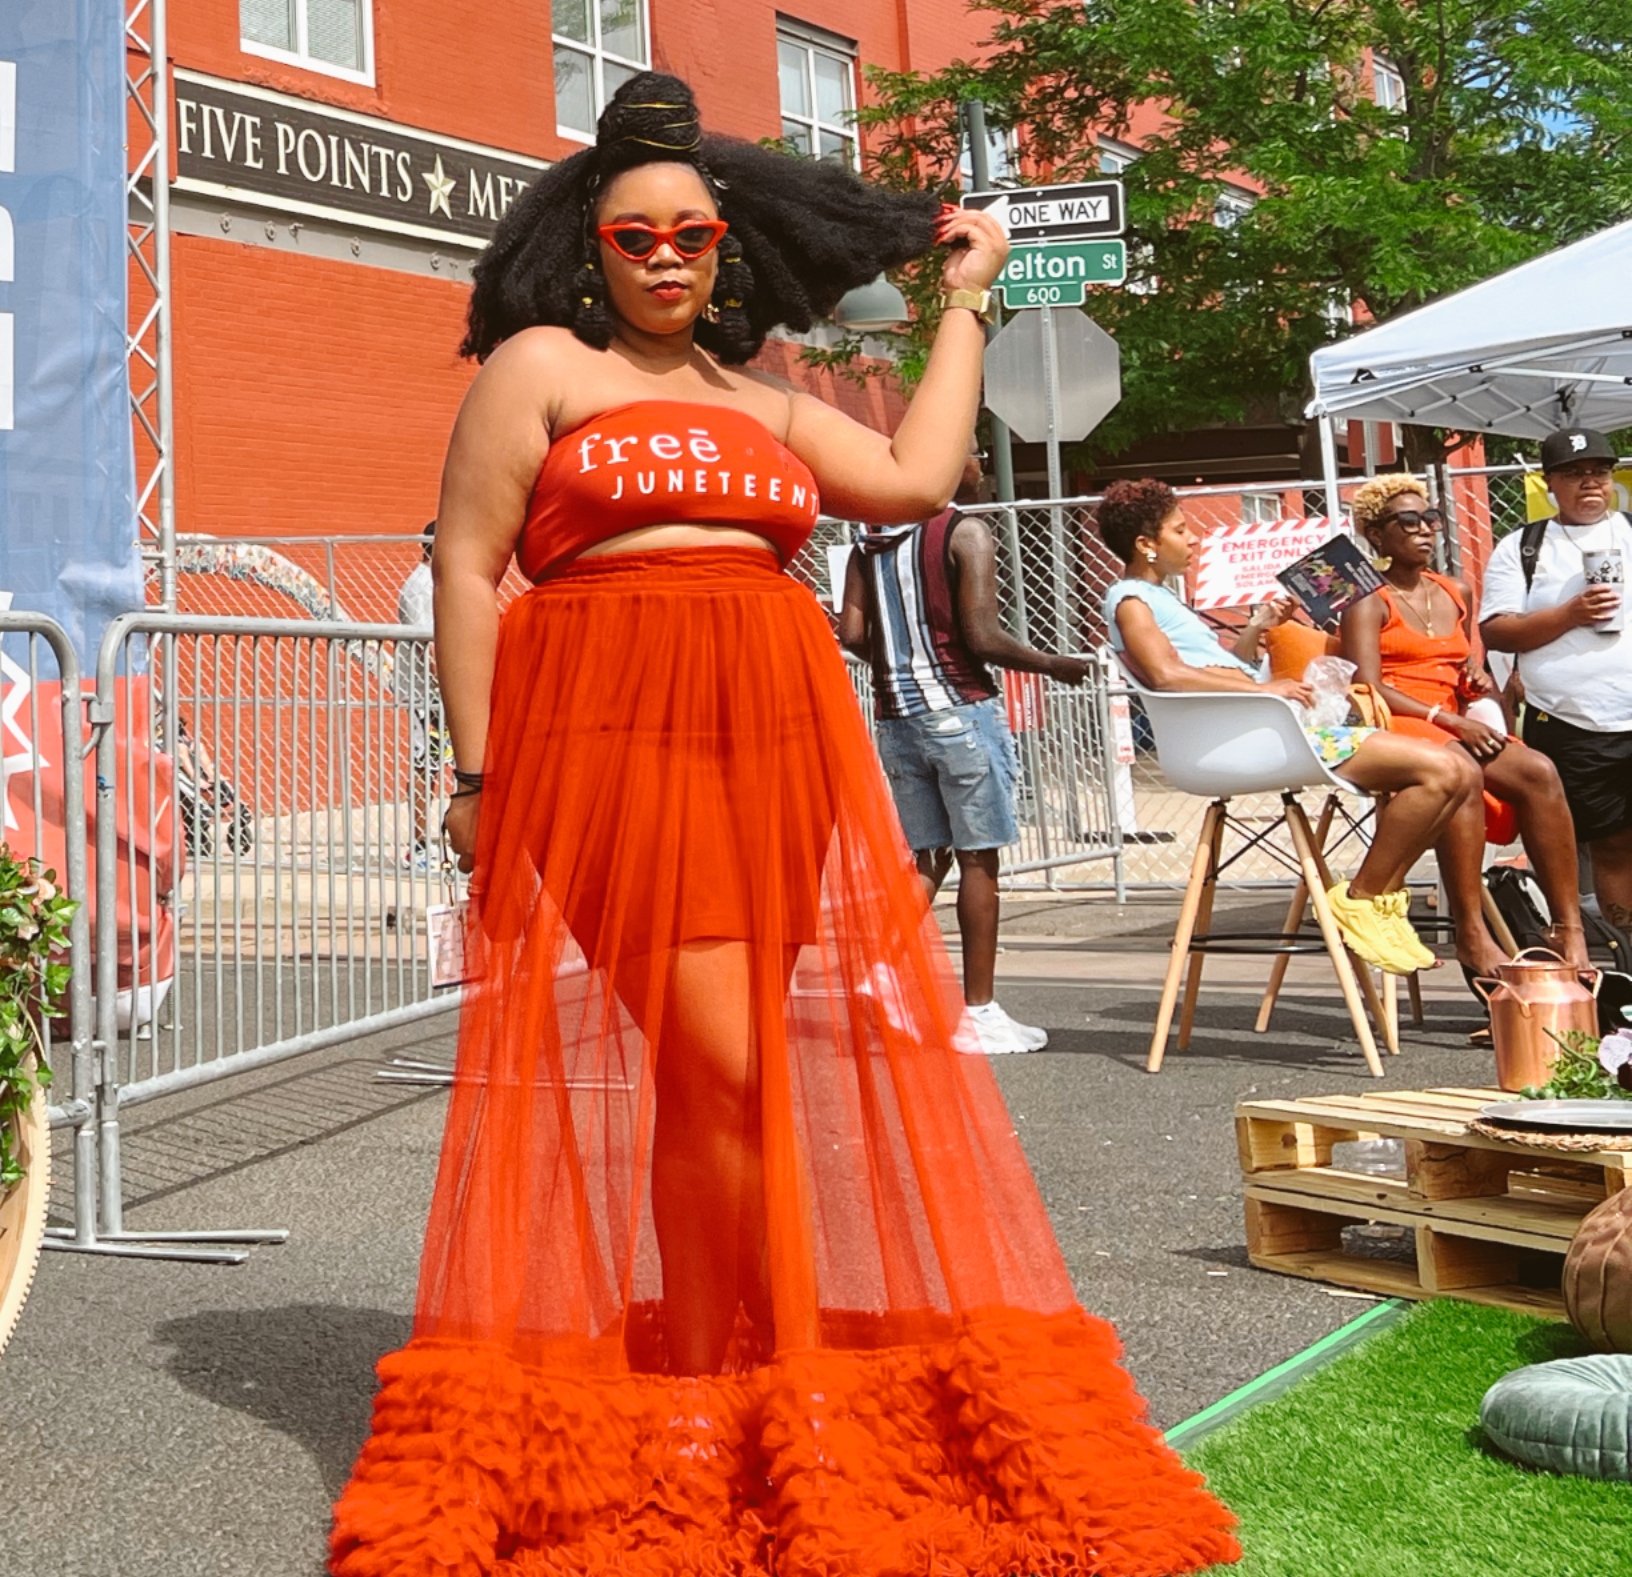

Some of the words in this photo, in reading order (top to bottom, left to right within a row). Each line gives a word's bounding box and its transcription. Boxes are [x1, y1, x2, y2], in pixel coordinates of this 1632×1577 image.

[176, 98, 264, 170] FIVE
[274, 121, 414, 202] POINTS
[1008, 204, 1050, 225] ONE
[1058, 199, 1102, 221] WAY
[998, 252, 1086, 281] elton
[1102, 253, 1117, 270] St
[1027, 286, 1061, 303] 600
[1222, 534, 1326, 552] EMERGENCY
[1229, 550, 1266, 563] EXIT
[1242, 562, 1281, 572] SALIDA
